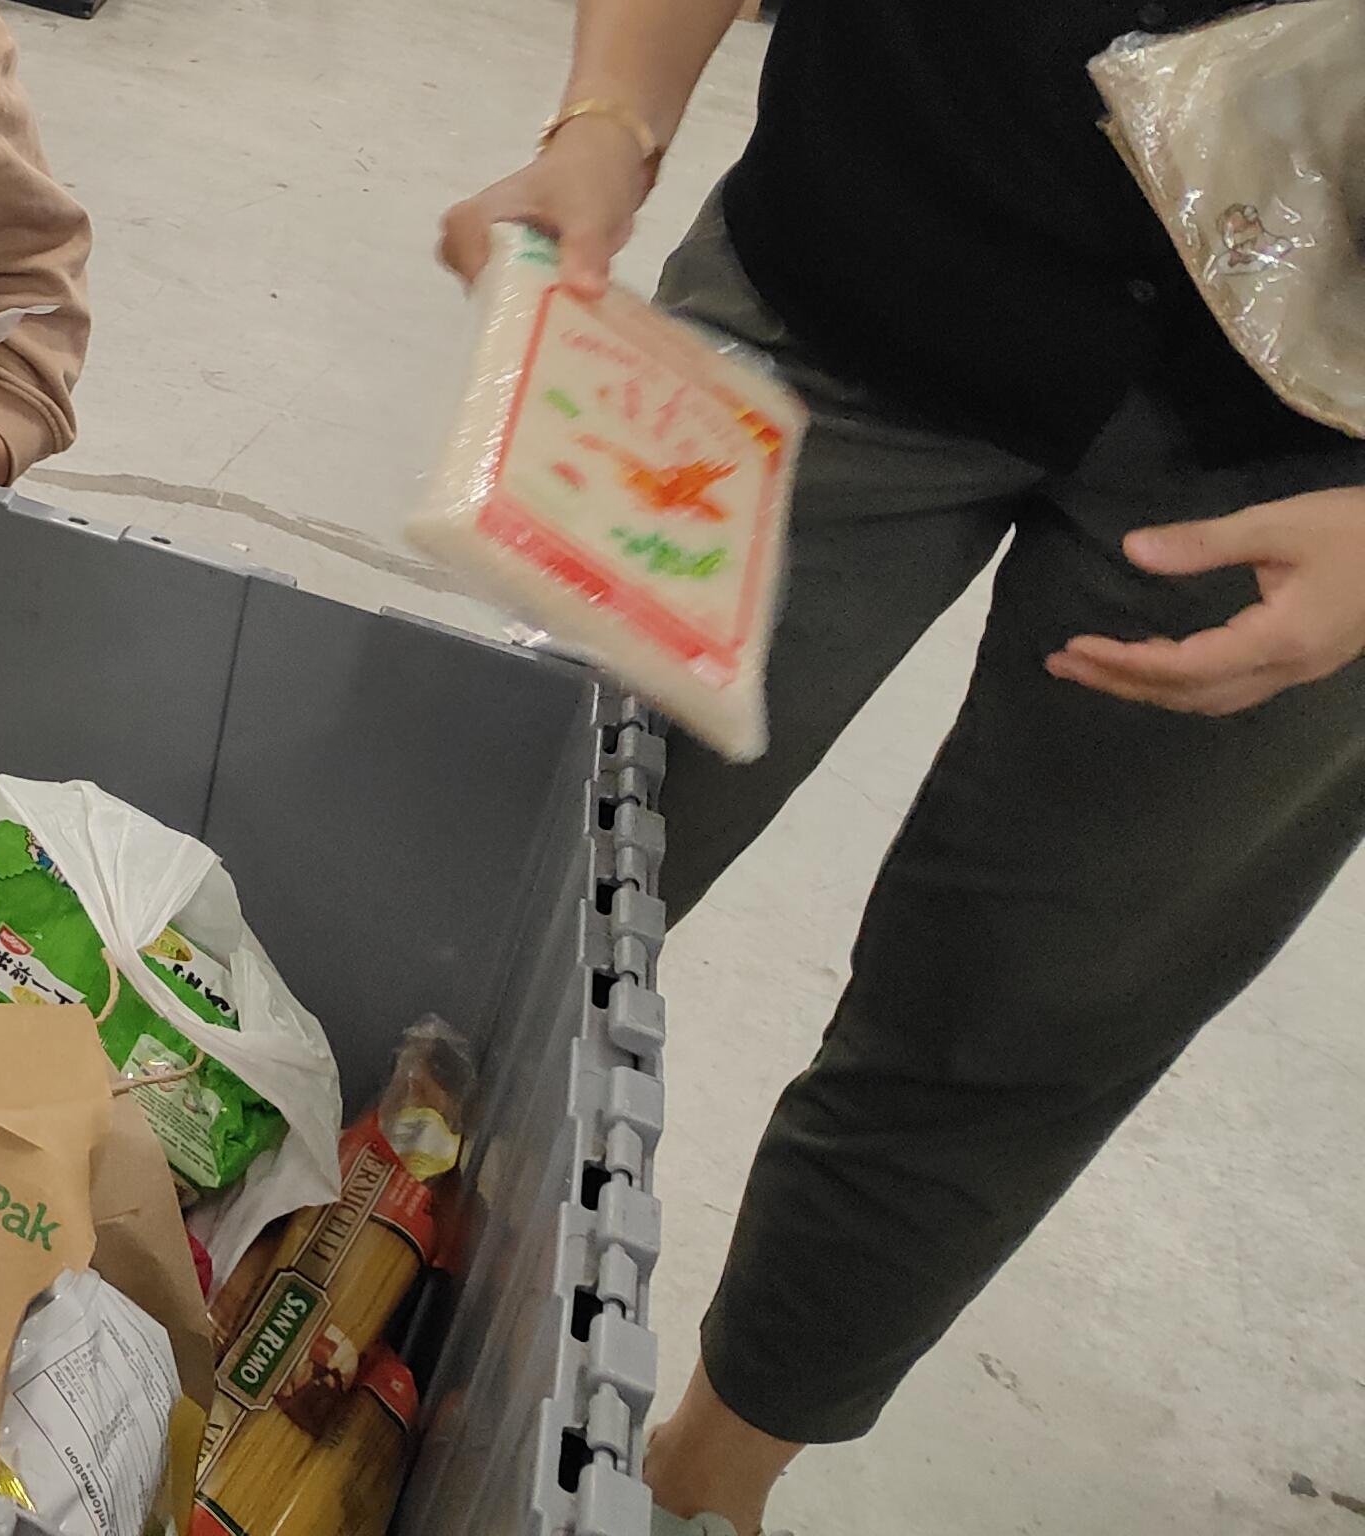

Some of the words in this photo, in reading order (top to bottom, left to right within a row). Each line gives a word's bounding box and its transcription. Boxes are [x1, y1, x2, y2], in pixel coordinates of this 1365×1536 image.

[274, 1291, 309, 1337] SAN
[240, 1332, 287, 1385] REMO
[64, 1445, 108, 1530] Information
